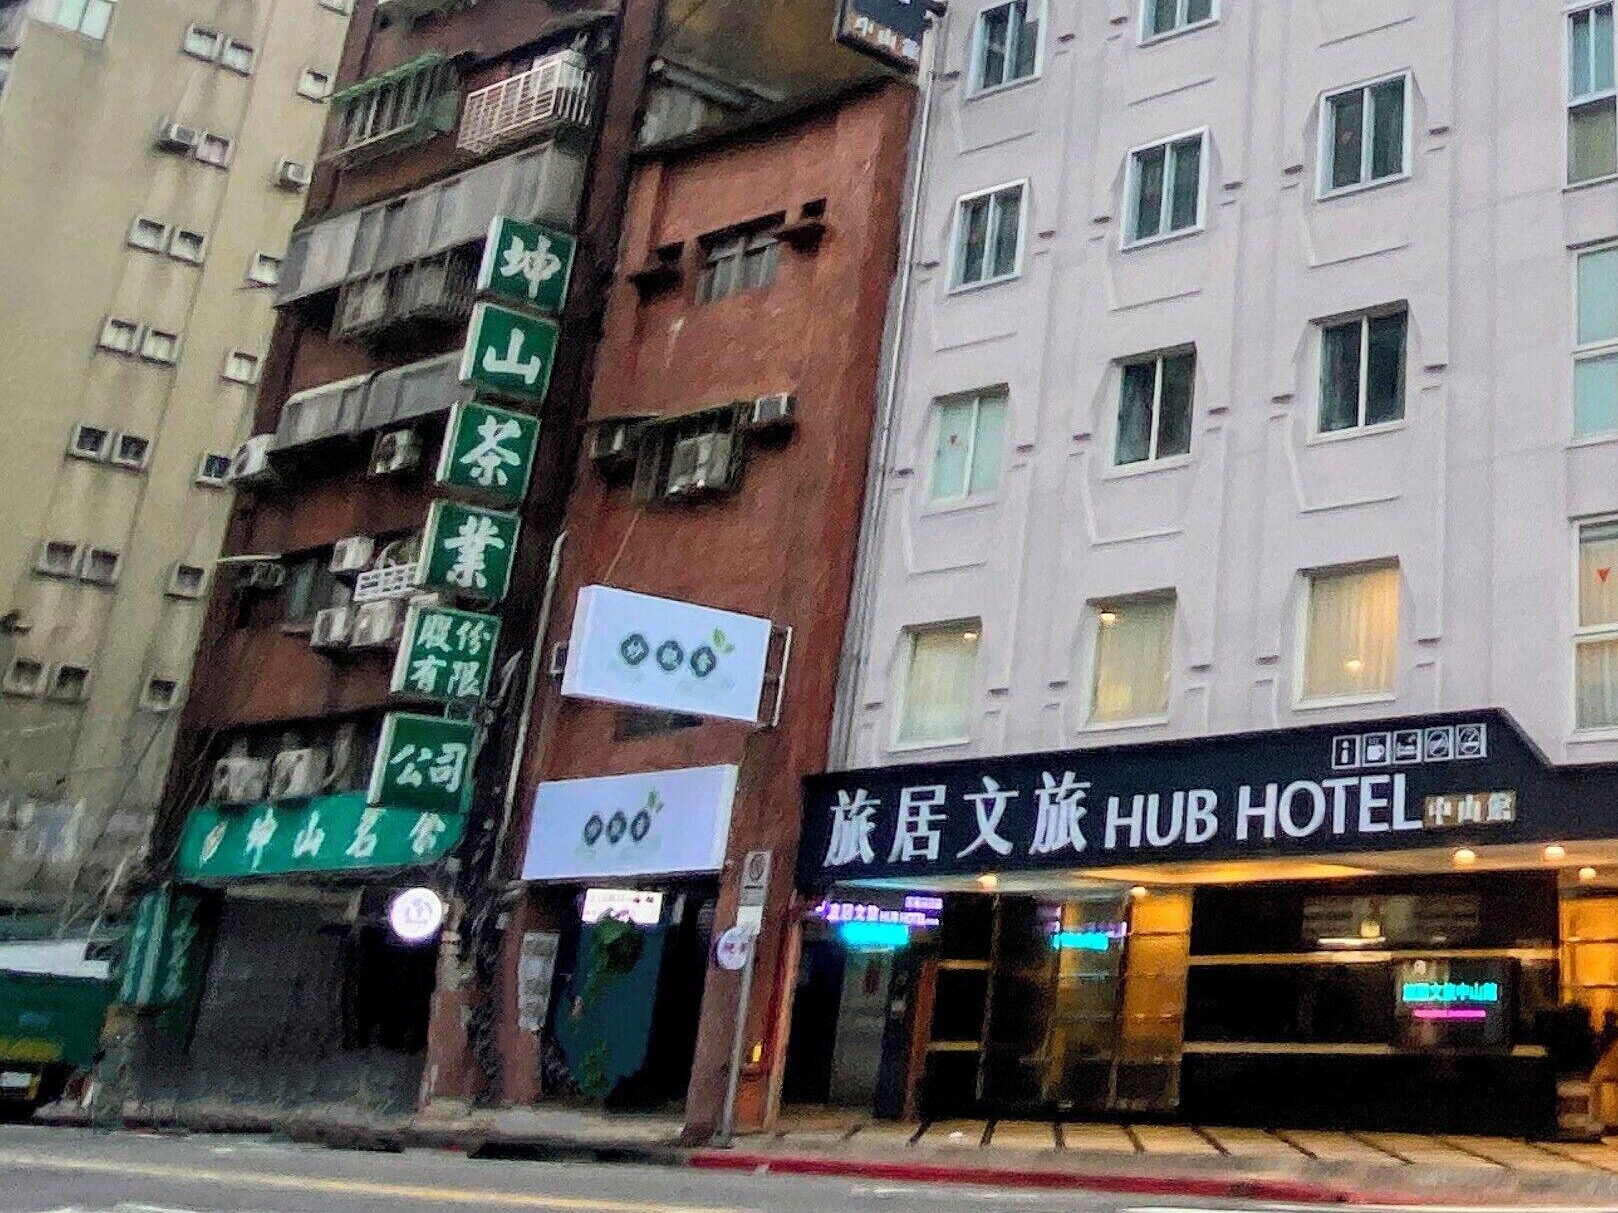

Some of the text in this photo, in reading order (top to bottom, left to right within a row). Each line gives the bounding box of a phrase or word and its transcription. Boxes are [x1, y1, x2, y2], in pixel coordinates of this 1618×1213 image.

[444, 234, 561, 589] 坤山茶業
[389, 741, 467, 792] 公司
[823, 770, 1424, 867] 旅居文旅 HUB HOTEL
